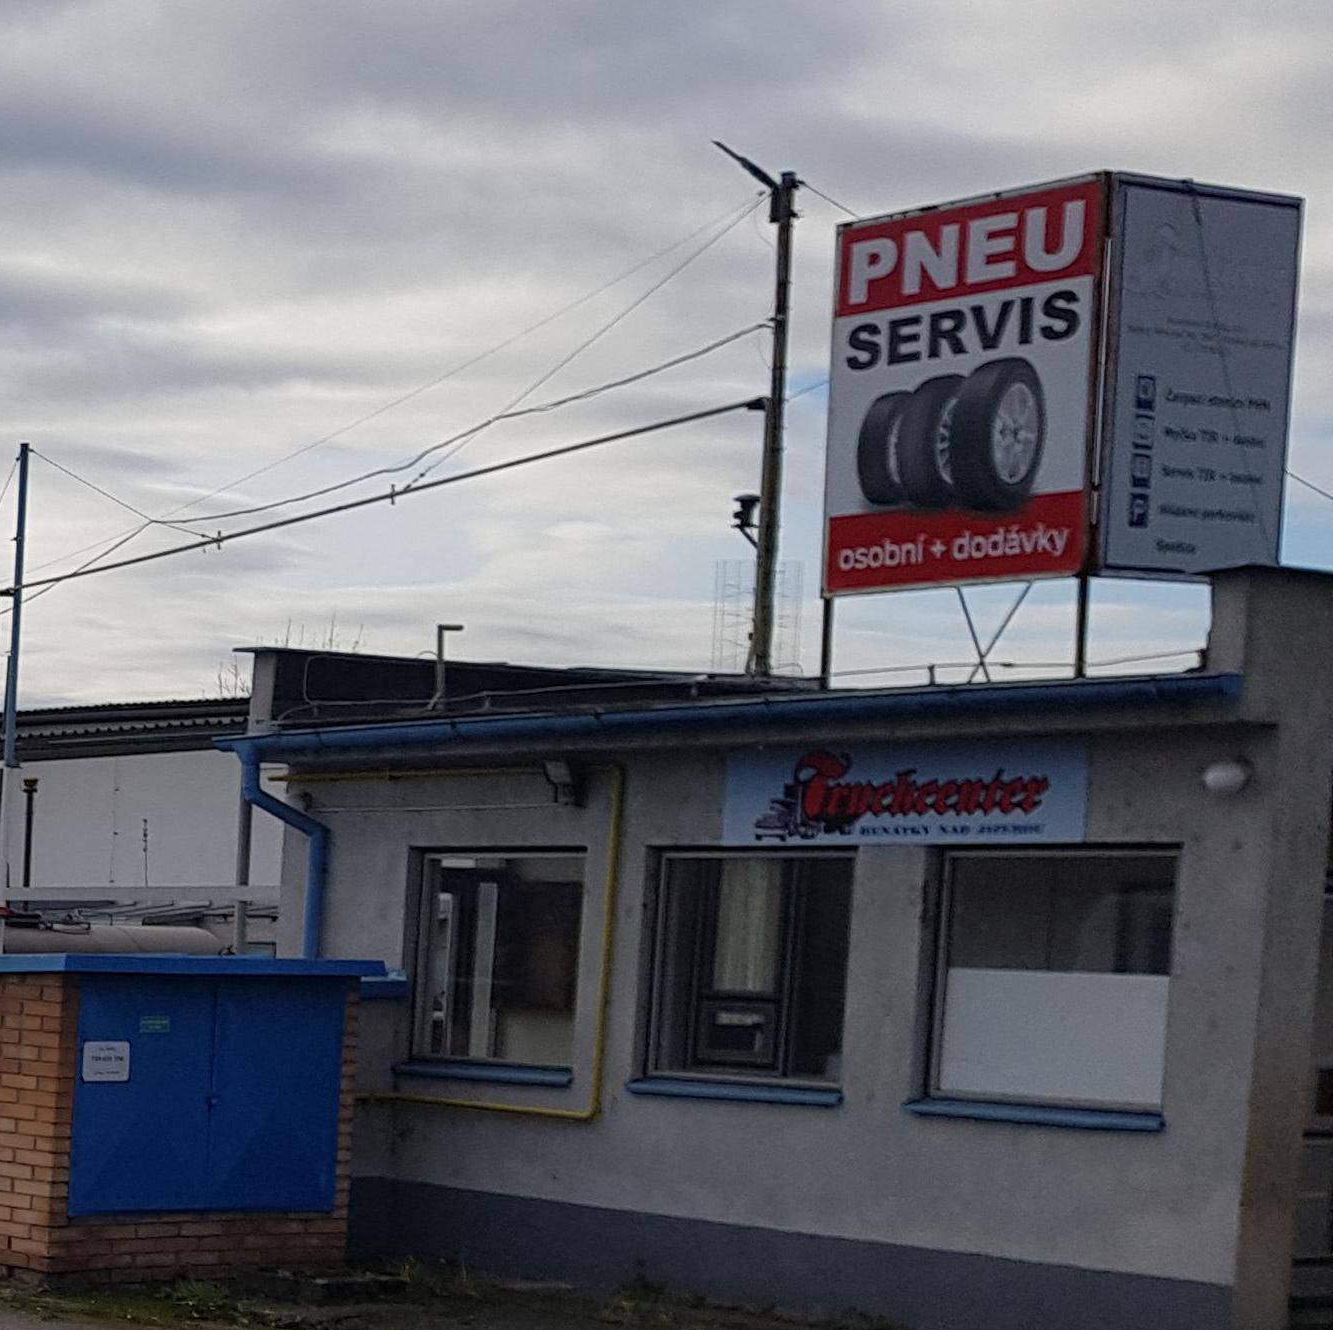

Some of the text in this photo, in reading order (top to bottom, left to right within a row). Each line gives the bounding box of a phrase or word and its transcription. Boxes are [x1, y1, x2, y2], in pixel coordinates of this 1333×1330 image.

[848, 200, 1086, 305] PNEU
[846, 289, 1082, 371] SERVIS
[839, 521, 1069, 571] osobní + dodávky
[796, 752, 1050, 823] Truckcenter
